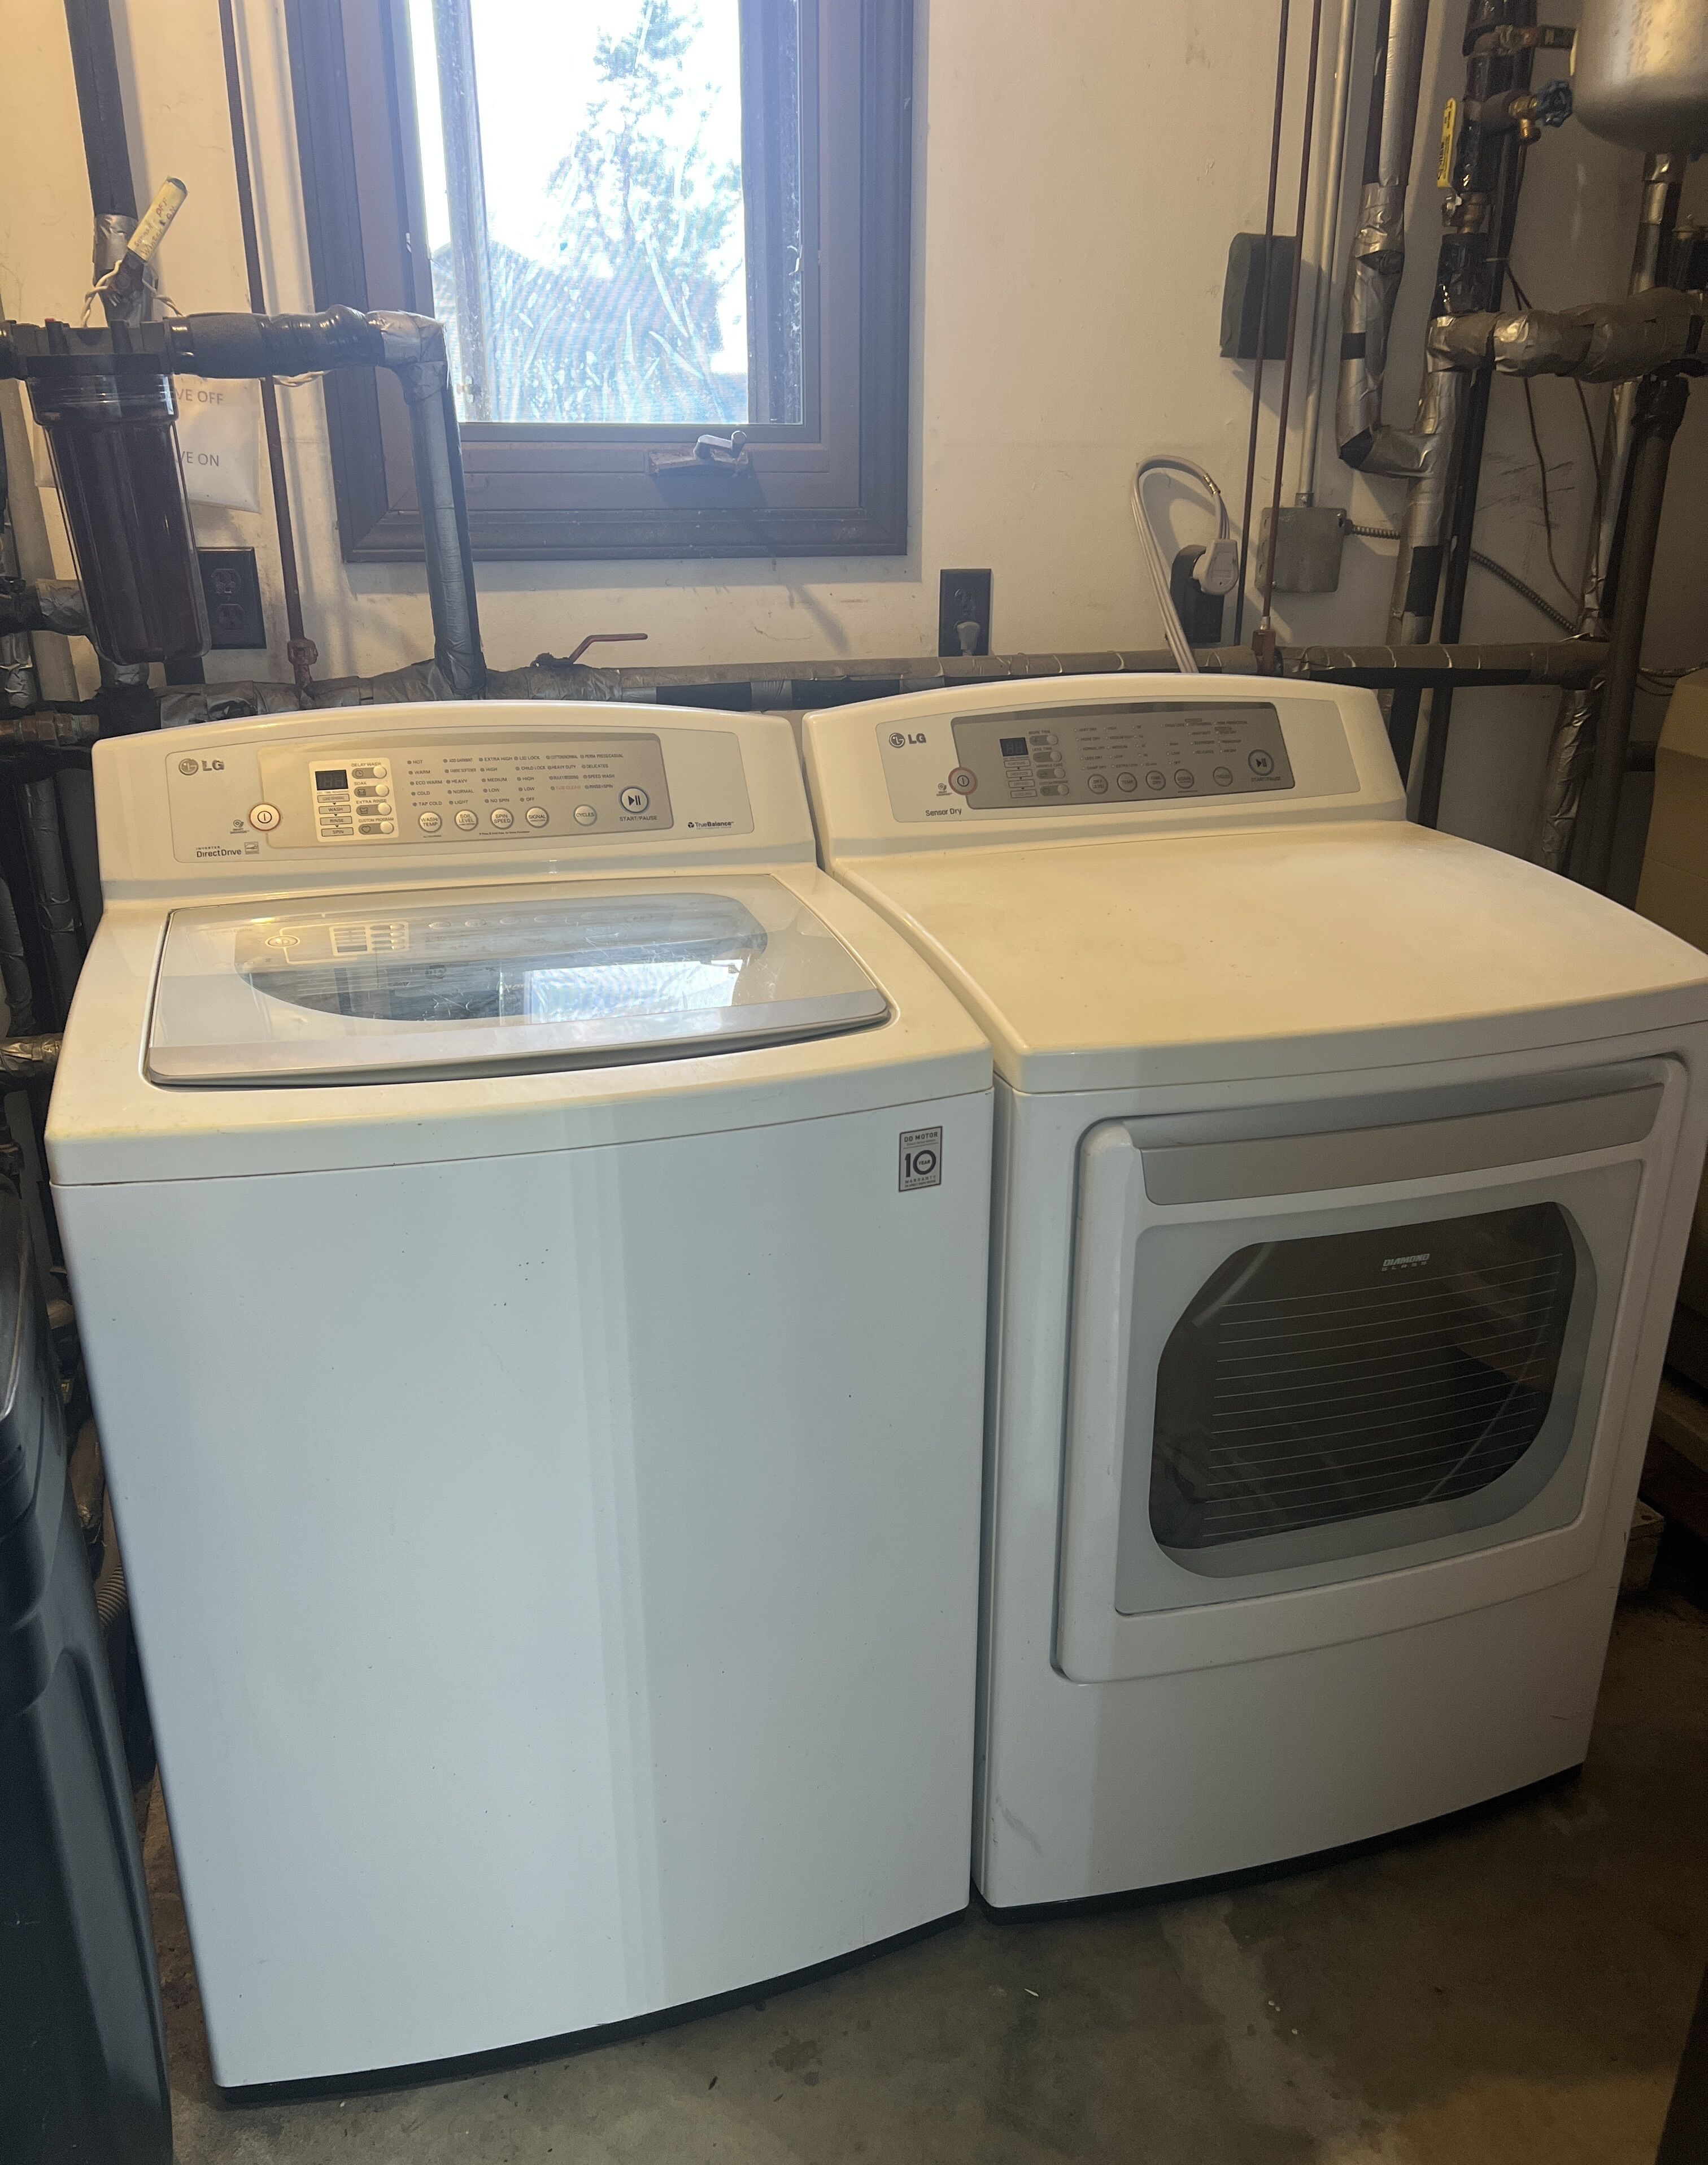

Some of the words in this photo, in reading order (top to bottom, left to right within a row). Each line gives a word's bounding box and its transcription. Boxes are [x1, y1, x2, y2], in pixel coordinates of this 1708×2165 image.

[197, 390, 224, 405] OFF
[198, 453, 219, 467] ON
[908, 733, 927, 745] LG
[201, 759, 224, 771] LG
[915, 1131, 938, 1140] MOTOR
[904, 1149, 937, 1178] 10
[905, 1175, 936, 1184] WARRANTY
